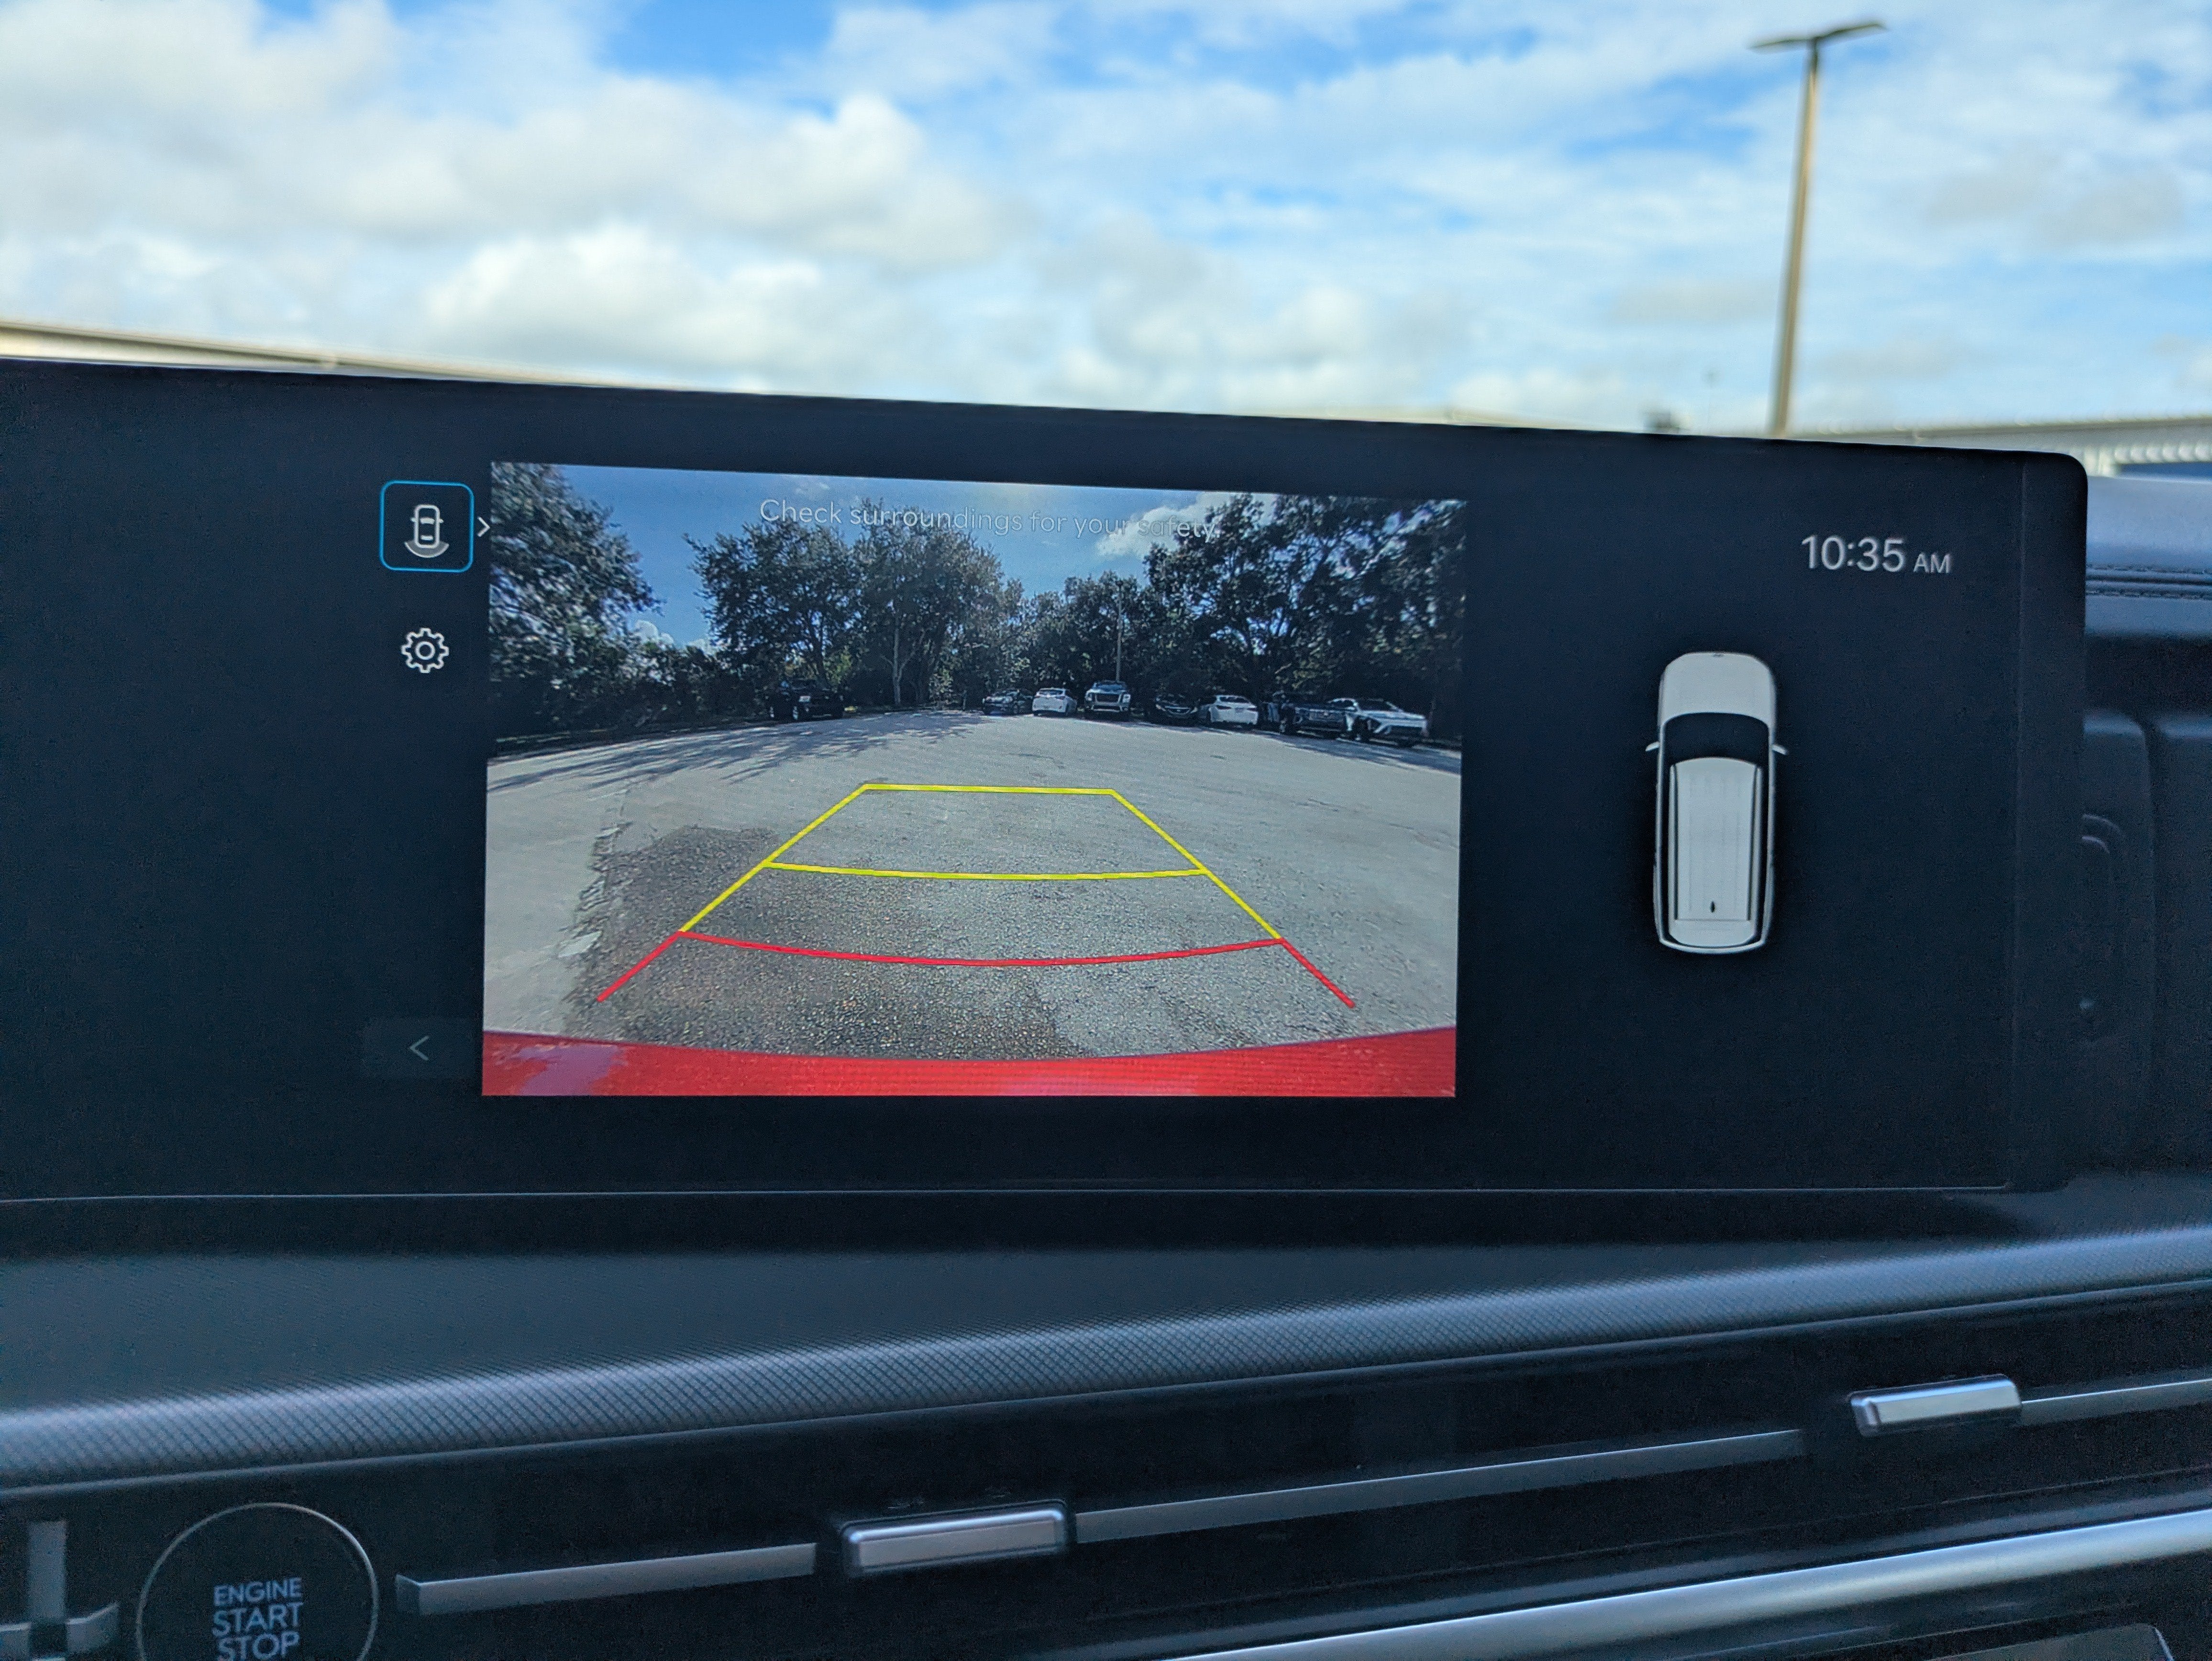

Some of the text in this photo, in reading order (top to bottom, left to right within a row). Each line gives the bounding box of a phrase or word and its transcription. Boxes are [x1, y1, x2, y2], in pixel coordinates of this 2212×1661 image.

[760, 498, 842, 524] Check
[850, 506, 1023, 536] surroundings
[1029, 510, 1067, 532] for
[1074, 518, 1130, 538] your
[1801, 534, 1952, 574] 10:35 AM
[213, 1577, 303, 1606] ENGINE
[212, 1602, 304, 1637] START
[217, 1630, 300, 1661] STOP
